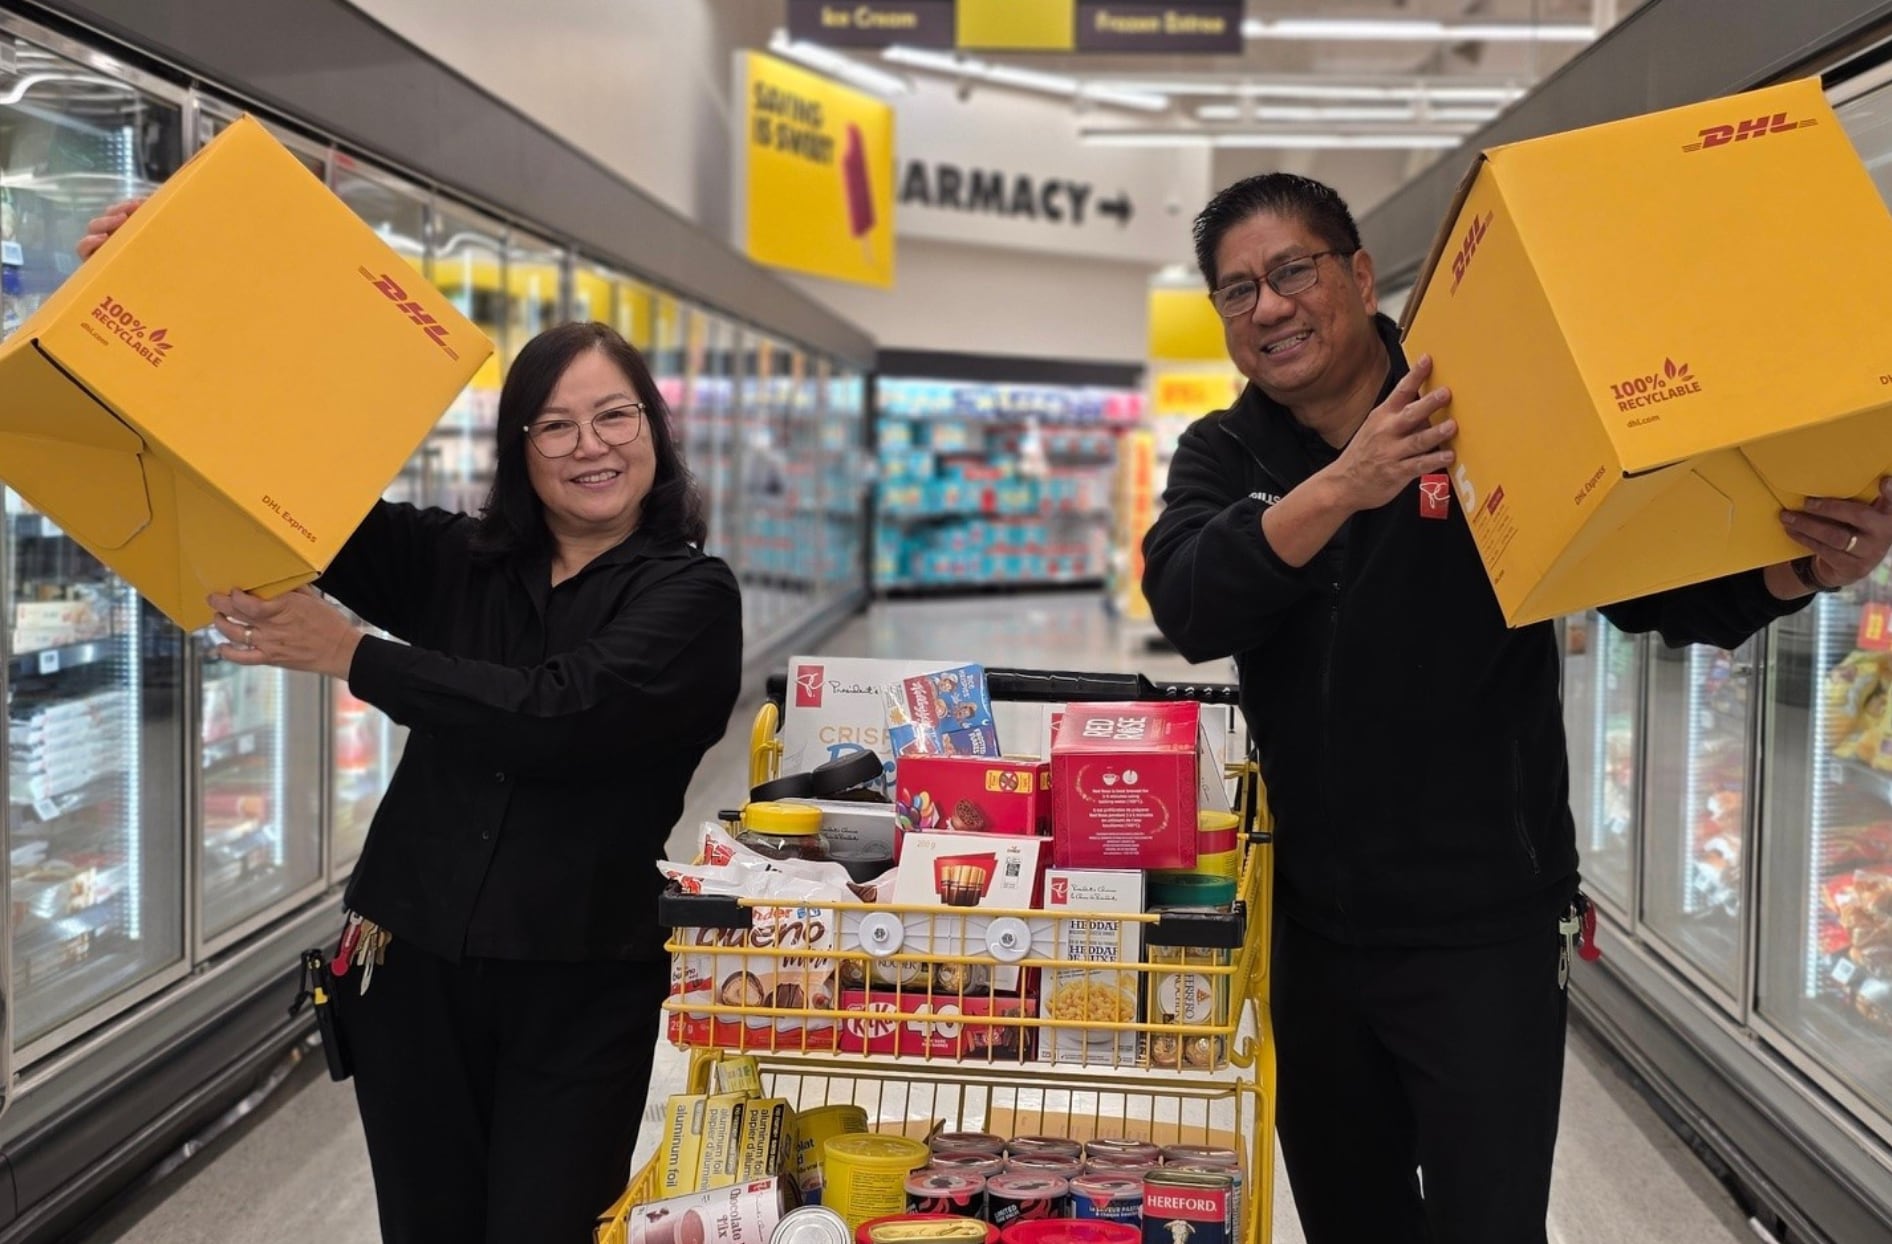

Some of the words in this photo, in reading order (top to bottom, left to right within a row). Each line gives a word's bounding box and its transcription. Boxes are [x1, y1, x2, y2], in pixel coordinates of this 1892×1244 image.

[821, 8, 851, 28] Ice
[855, 8, 918, 29] Cream
[1095, 12, 1159, 33] Frozen
[1698, 112, 1798, 149] DHL
[1451, 213, 1486, 285] DHL
[100, 295, 147, 339] 100%
[371, 273, 449, 347] DHL
[91, 307, 163, 368] RECYCLABLE
[1610, 373, 1666, 400] 100%
[1617, 381, 1702, 413] RECYCLABLE
[1626, 415, 1660, 428] dhl.com
[1584, 465, 1606, 491] Express
[262, 495, 281, 515] DHL
[281, 511, 317, 543] Express
[1083, 718, 1115, 738] RED
[906, 1003, 961, 1039] 40
[670, 1104, 687, 1166] aluminum
[707, 1108, 718, 1140] papier
[715, 1107, 729, 1158] aluminum
[748, 1109, 760, 1140] papier
[755, 1108, 769, 1158] aluminum
[666, 1167, 678, 1188] foil
[713, 1160, 723, 1175] foil
[754, 1159, 764, 1175] foil
[729, 1187, 743, 1241] Chocolate
